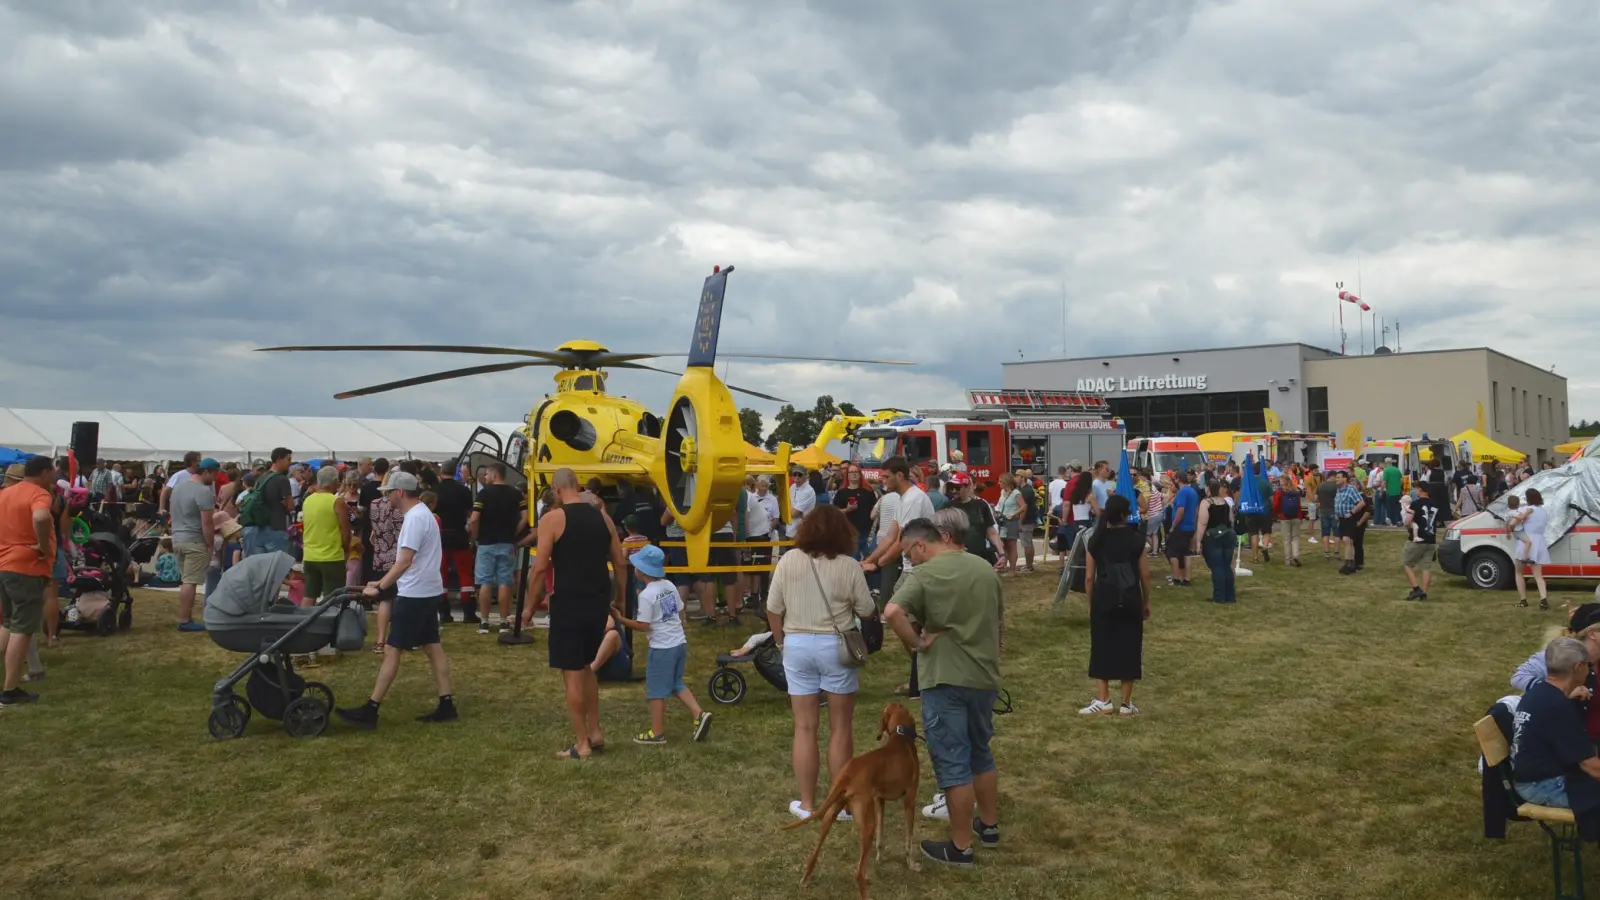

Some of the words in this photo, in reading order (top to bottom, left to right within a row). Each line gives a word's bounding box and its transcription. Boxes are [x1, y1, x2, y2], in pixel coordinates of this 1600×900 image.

[1076, 377, 1116, 393] ADAC
[1119, 374, 1208, 392] Luftrettung
[1014, 420, 1061, 429] FEUERWEHR
[1062, 420, 1113, 429] DINKELSBÜHL
[977, 469, 990, 478] 112
